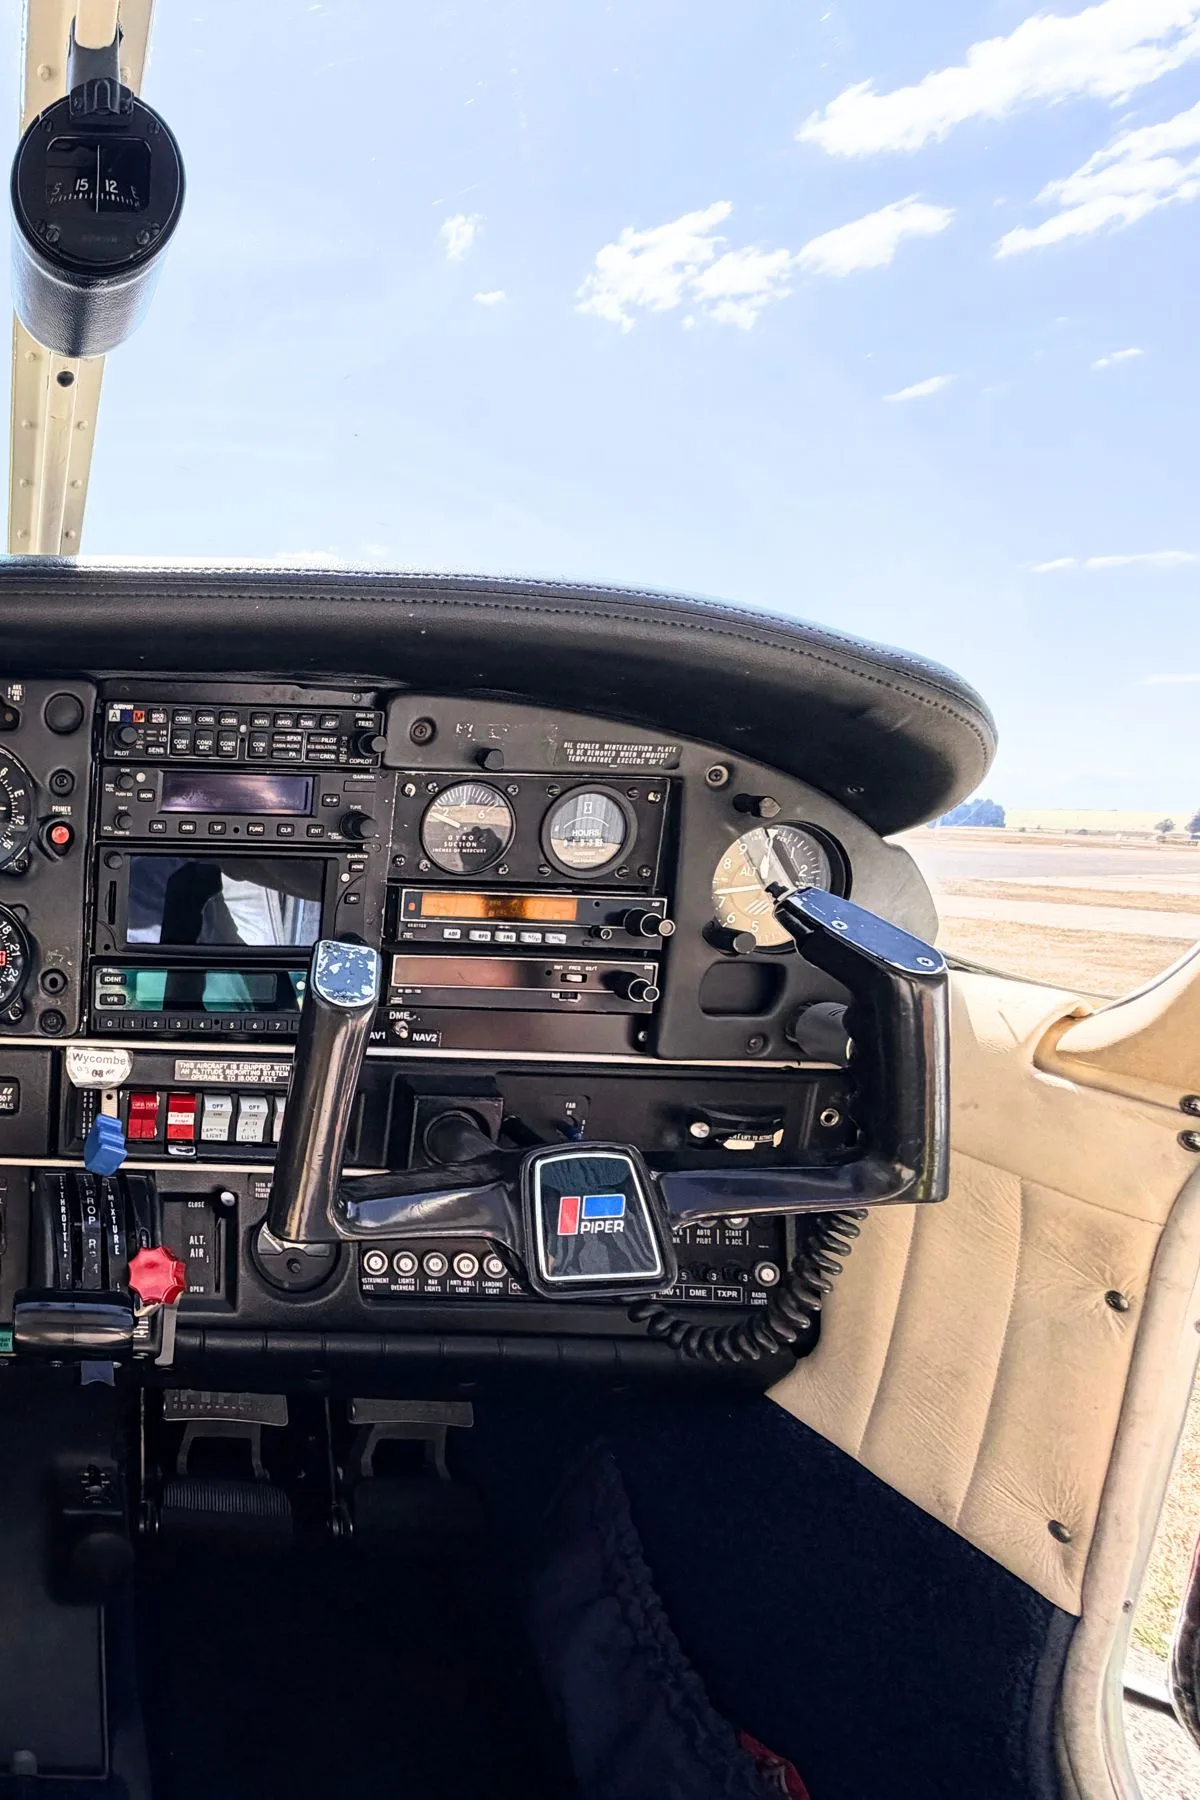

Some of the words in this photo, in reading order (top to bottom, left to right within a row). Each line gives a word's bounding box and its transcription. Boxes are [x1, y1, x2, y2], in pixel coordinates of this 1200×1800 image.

[76, 179, 88, 191] 15
[106, 180, 118, 193] 12
[390, 1012, 410, 1020] DME
[412, 1032, 437, 1042] NAV2
[72, 1052, 126, 1067] Wycombe
[108, 1194, 120, 1254] MIXTURE
[580, 1220, 624, 1235] PIPER
[190, 1236, 206, 1245] ALT.
[190, 1248, 204, 1258] AIR
[689, 1289, 707, 1297] DME
[717, 1290, 737, 1298] TXPR
